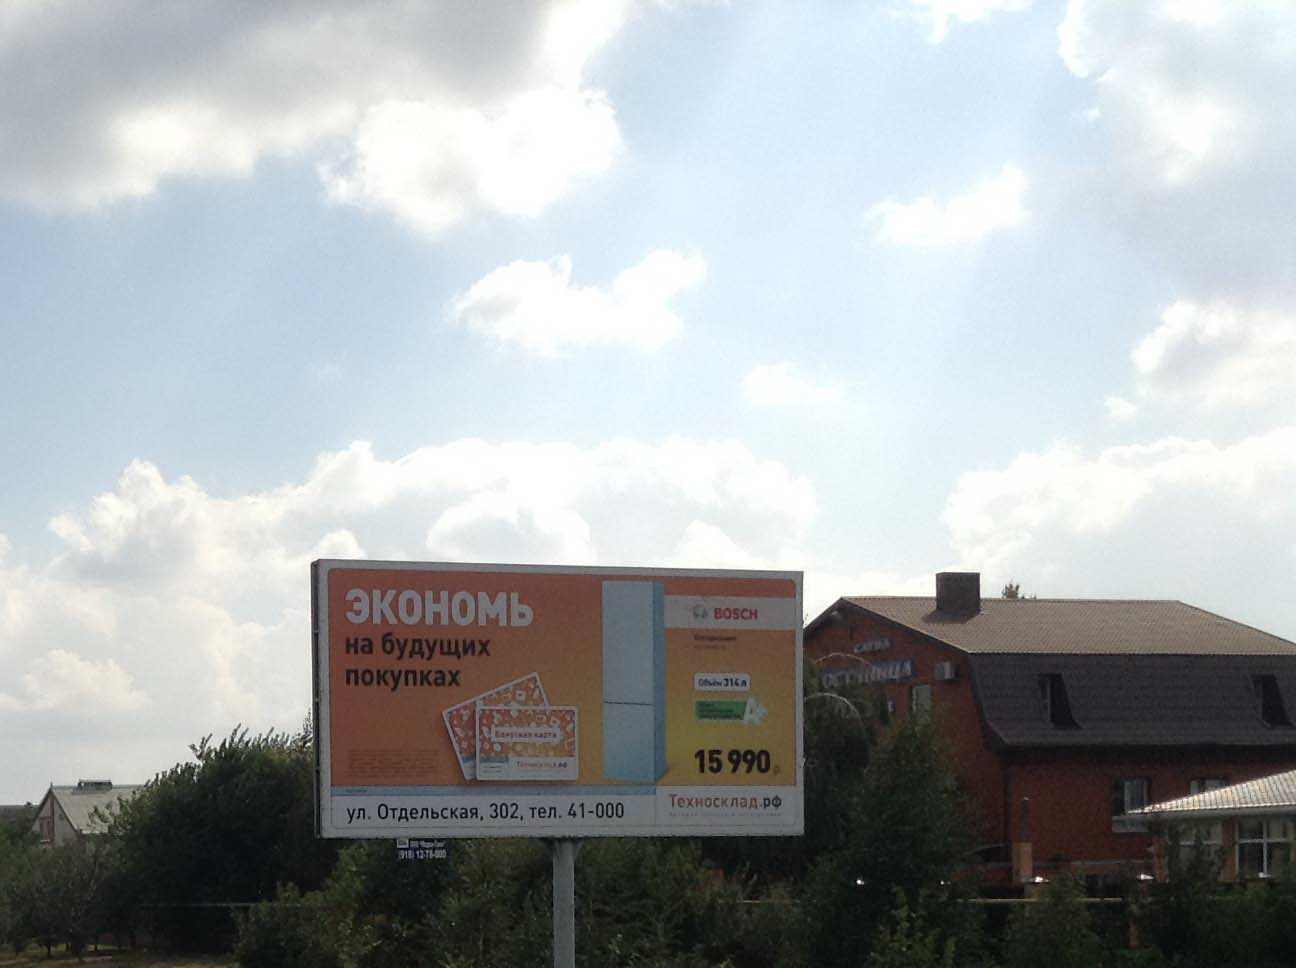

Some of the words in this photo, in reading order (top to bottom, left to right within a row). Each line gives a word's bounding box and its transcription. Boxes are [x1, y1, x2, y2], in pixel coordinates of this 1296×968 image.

[344, 587, 534, 627] ЭКОНОМЬ
[713, 607, 758, 620] BOSCH
[345, 636, 374, 655] на
[381, 632, 491, 660] будущих
[345, 668, 462, 691] покупках
[694, 749, 723, 774] 15
[727, 749, 771, 774] 990
[347, 806, 371, 824] ул.
[377, 803, 484, 822] Отдельская,
[489, 802, 524, 822] 302,
[529, 804, 562, 819] тел.
[567, 802, 625, 819] 41-000
[669, 793, 783, 810] Техносклад.рф
